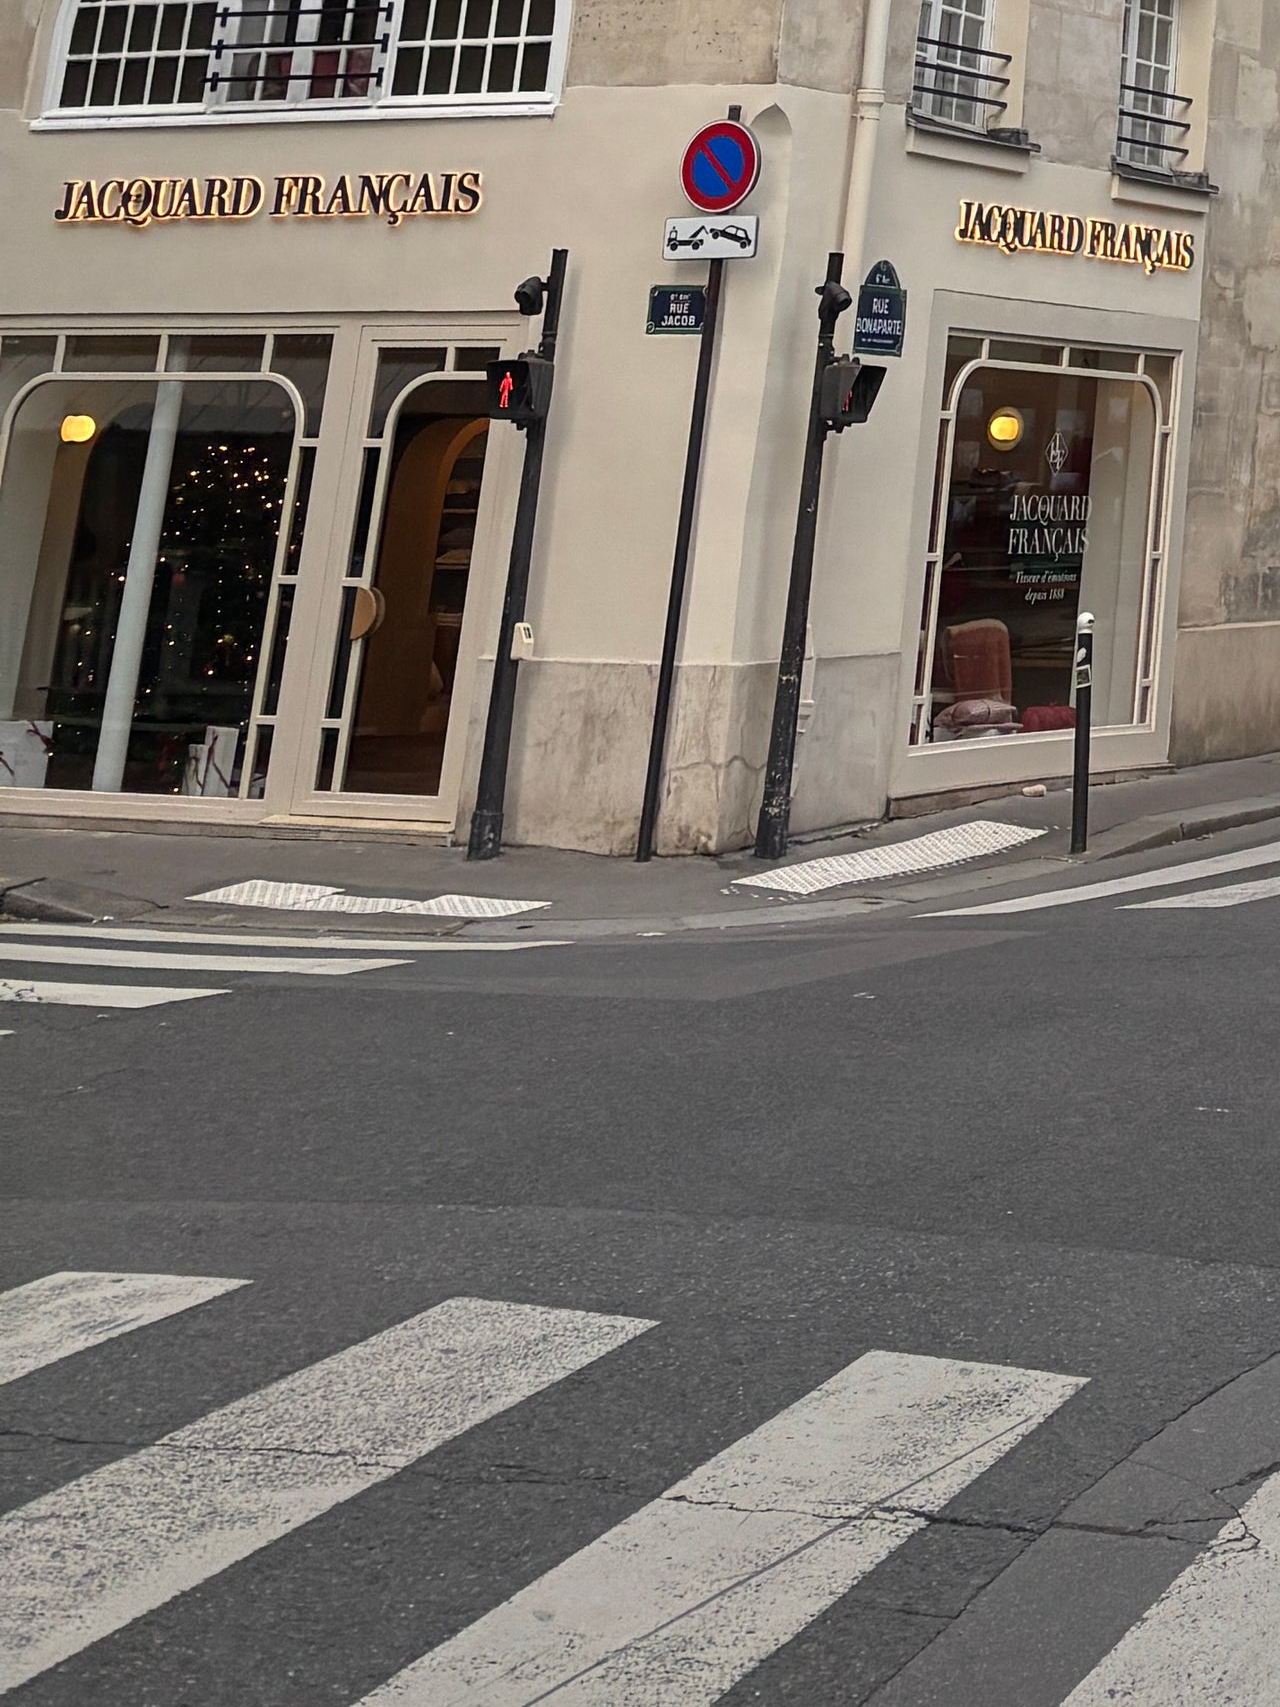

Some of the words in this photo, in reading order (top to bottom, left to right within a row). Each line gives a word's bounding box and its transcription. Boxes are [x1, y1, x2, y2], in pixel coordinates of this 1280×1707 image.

[54, 175, 265, 226] JACQUARD
[268, 171, 481, 226] FRANÇAIS
[954, 198, 1085, 256] JACQUARD
[1083, 217, 1196, 276] FRANÇAIS
[670, 302, 690, 314] RUE
[872, 297, 890, 315] RUE
[661, 315, 696, 326] JACOB
[856, 317, 903, 336] BONAPARTE
[1009, 494, 1093, 526] JACQUARD
[1007, 527, 1090, 562] FRANÇAIS
[1025, 587, 1047, 605] depuis
